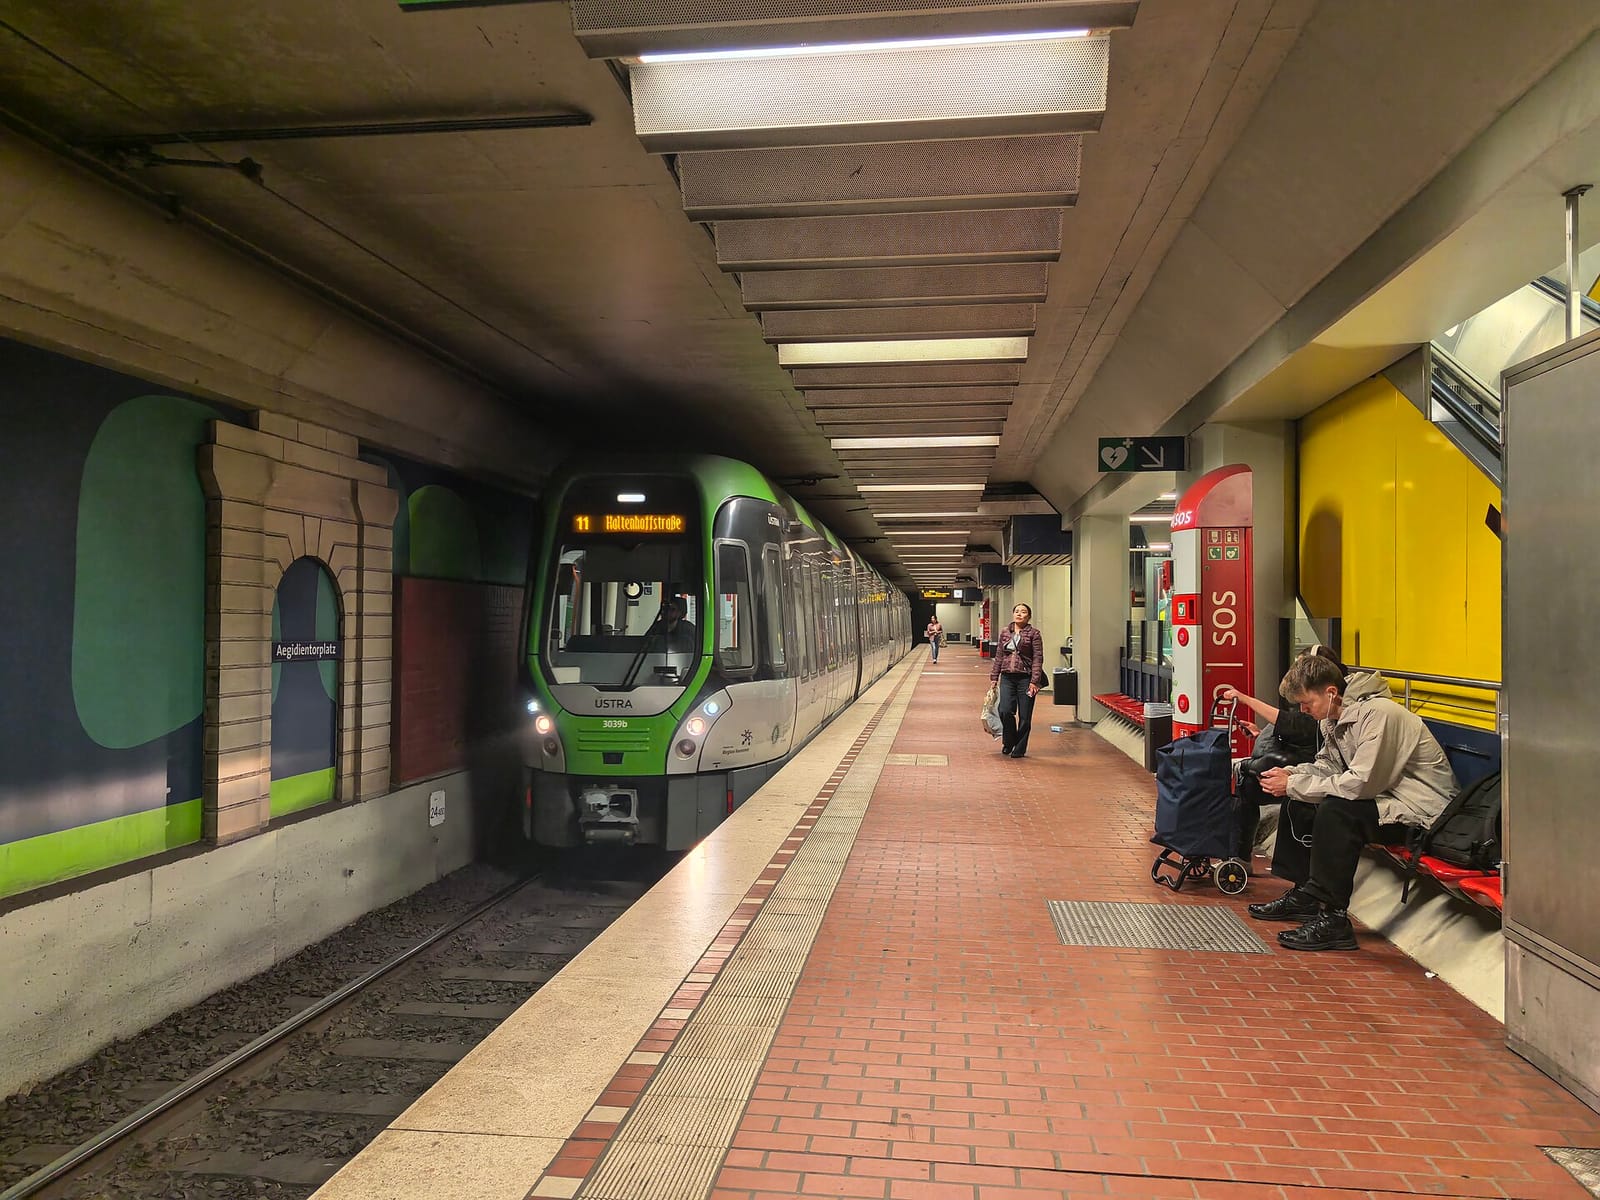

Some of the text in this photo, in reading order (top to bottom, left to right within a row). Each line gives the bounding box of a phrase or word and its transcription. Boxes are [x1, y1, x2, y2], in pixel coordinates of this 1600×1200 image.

[576, 515, 589, 530] 11
[1212, 590, 1237, 646] SOS
[276, 642, 336, 659] Aegidientorplatz
[602, 720, 628, 728] 3039b
